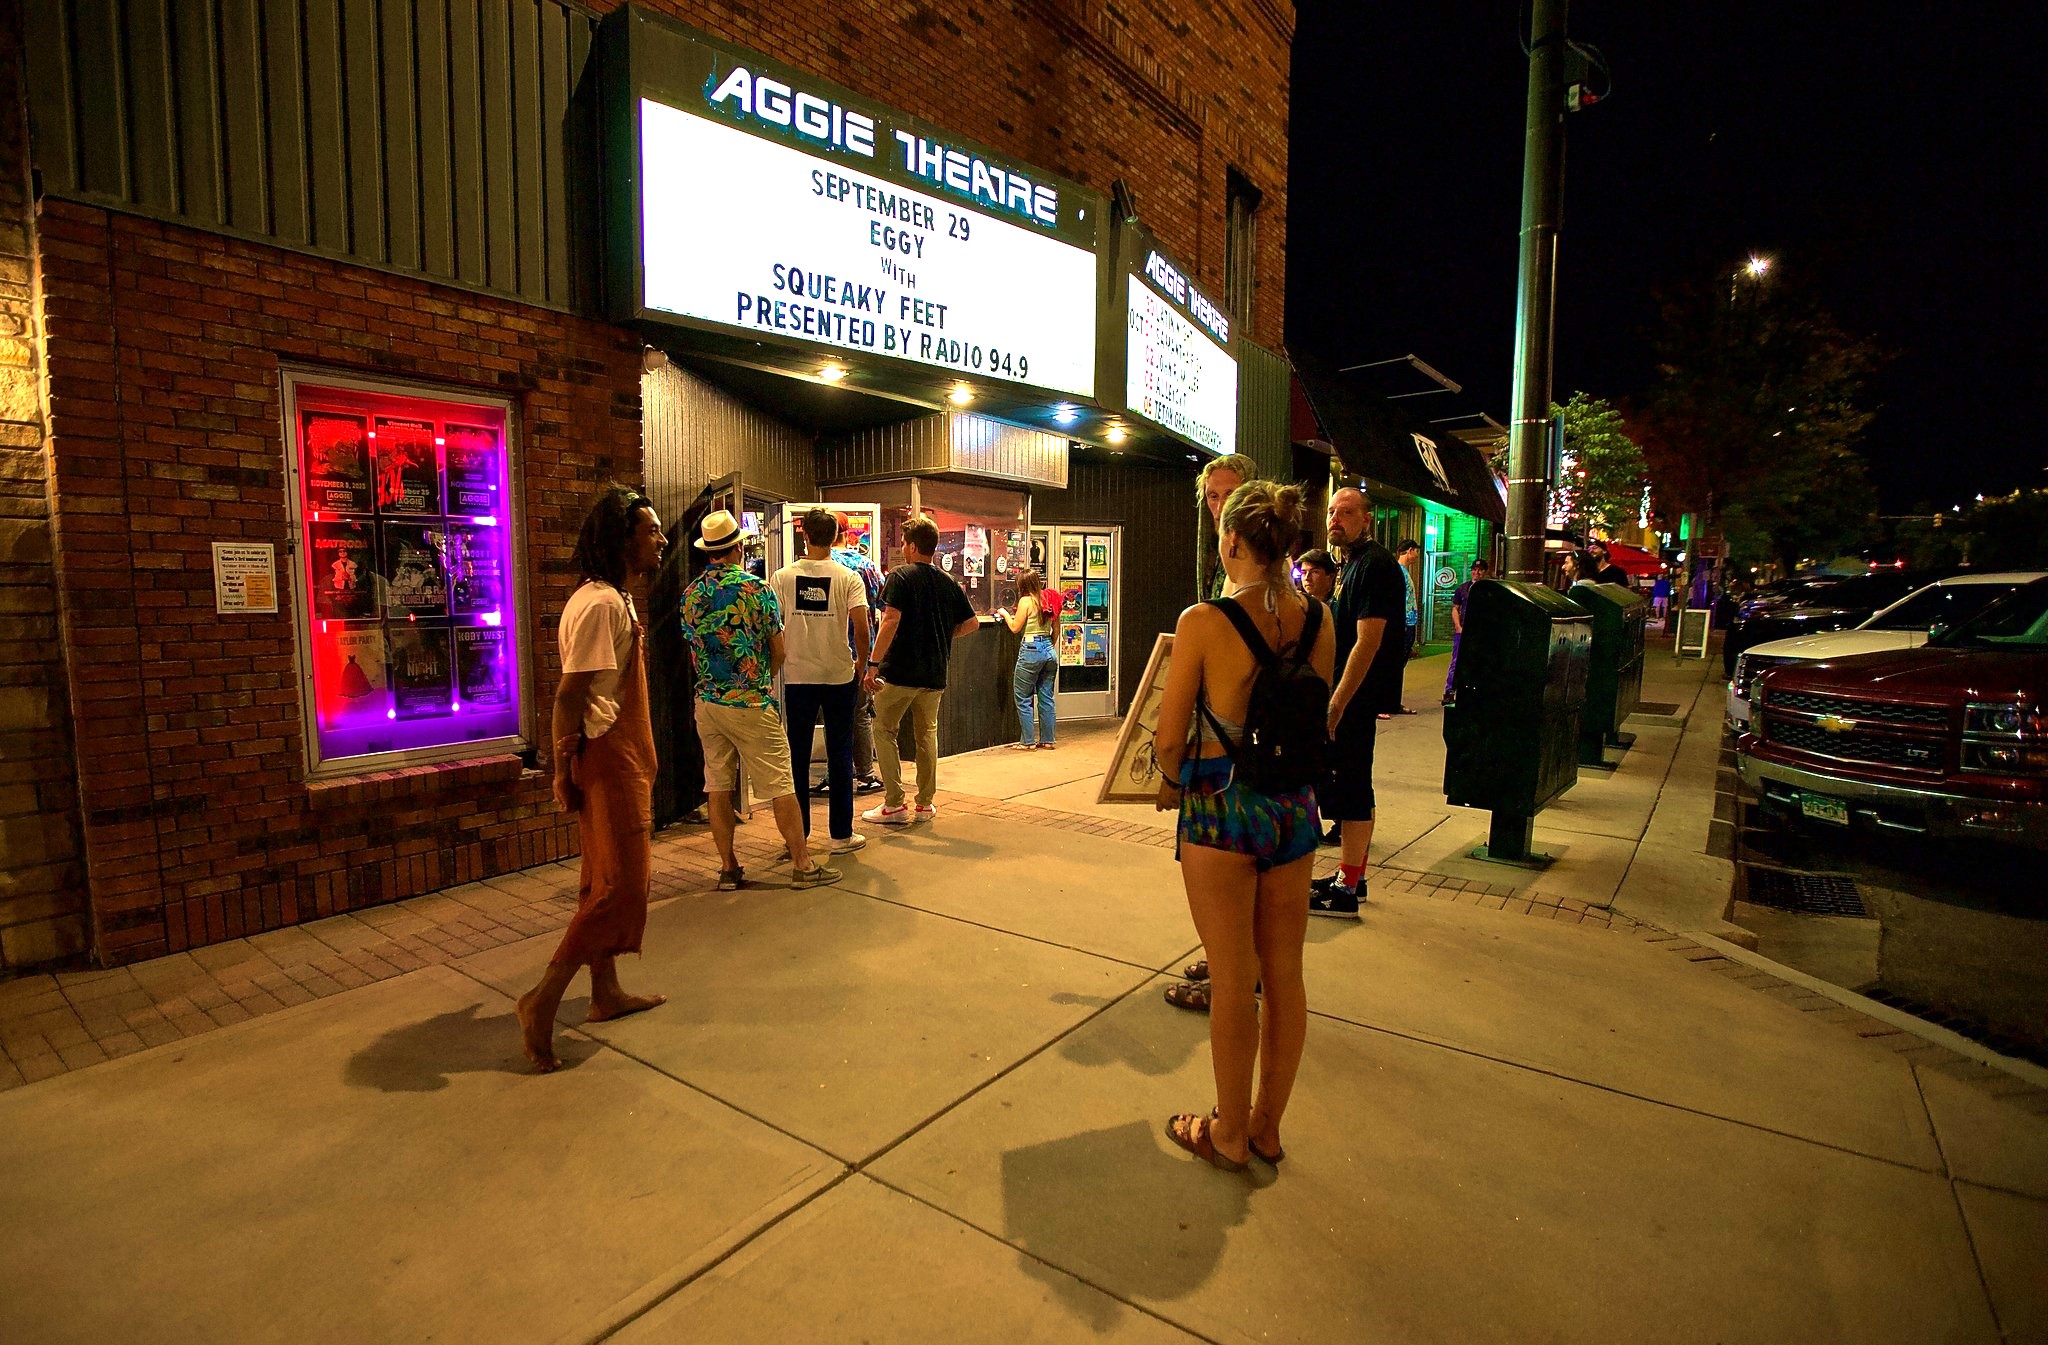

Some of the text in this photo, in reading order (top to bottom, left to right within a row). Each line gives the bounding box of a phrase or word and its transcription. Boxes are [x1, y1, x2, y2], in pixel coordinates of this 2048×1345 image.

[710, 66, 1057, 224] AGGIE THEATRE
[811, 169, 970, 242] SEPTEMBER 29
[870, 219, 924, 259] EGGY
[880, 256, 916, 289] WITH
[772, 263, 948, 329] SQUEAKY FEET
[1145, 250, 1186, 305] AGGIE
[1188, 285, 1229, 343] THEATRE
[737, 292, 1029, 379] PRESENTED BY RADIO 94.9
[1129, 308, 1144, 335] OCT
[1154, 400, 1173, 426] TETON
[329, 492, 351, 500] AGGIE
[398, 497, 423, 505] AGGIE
[462, 494, 488, 503] AGGIE
[482, 630, 506, 640] WEST
[1907, 748, 1929, 759] LTZ
